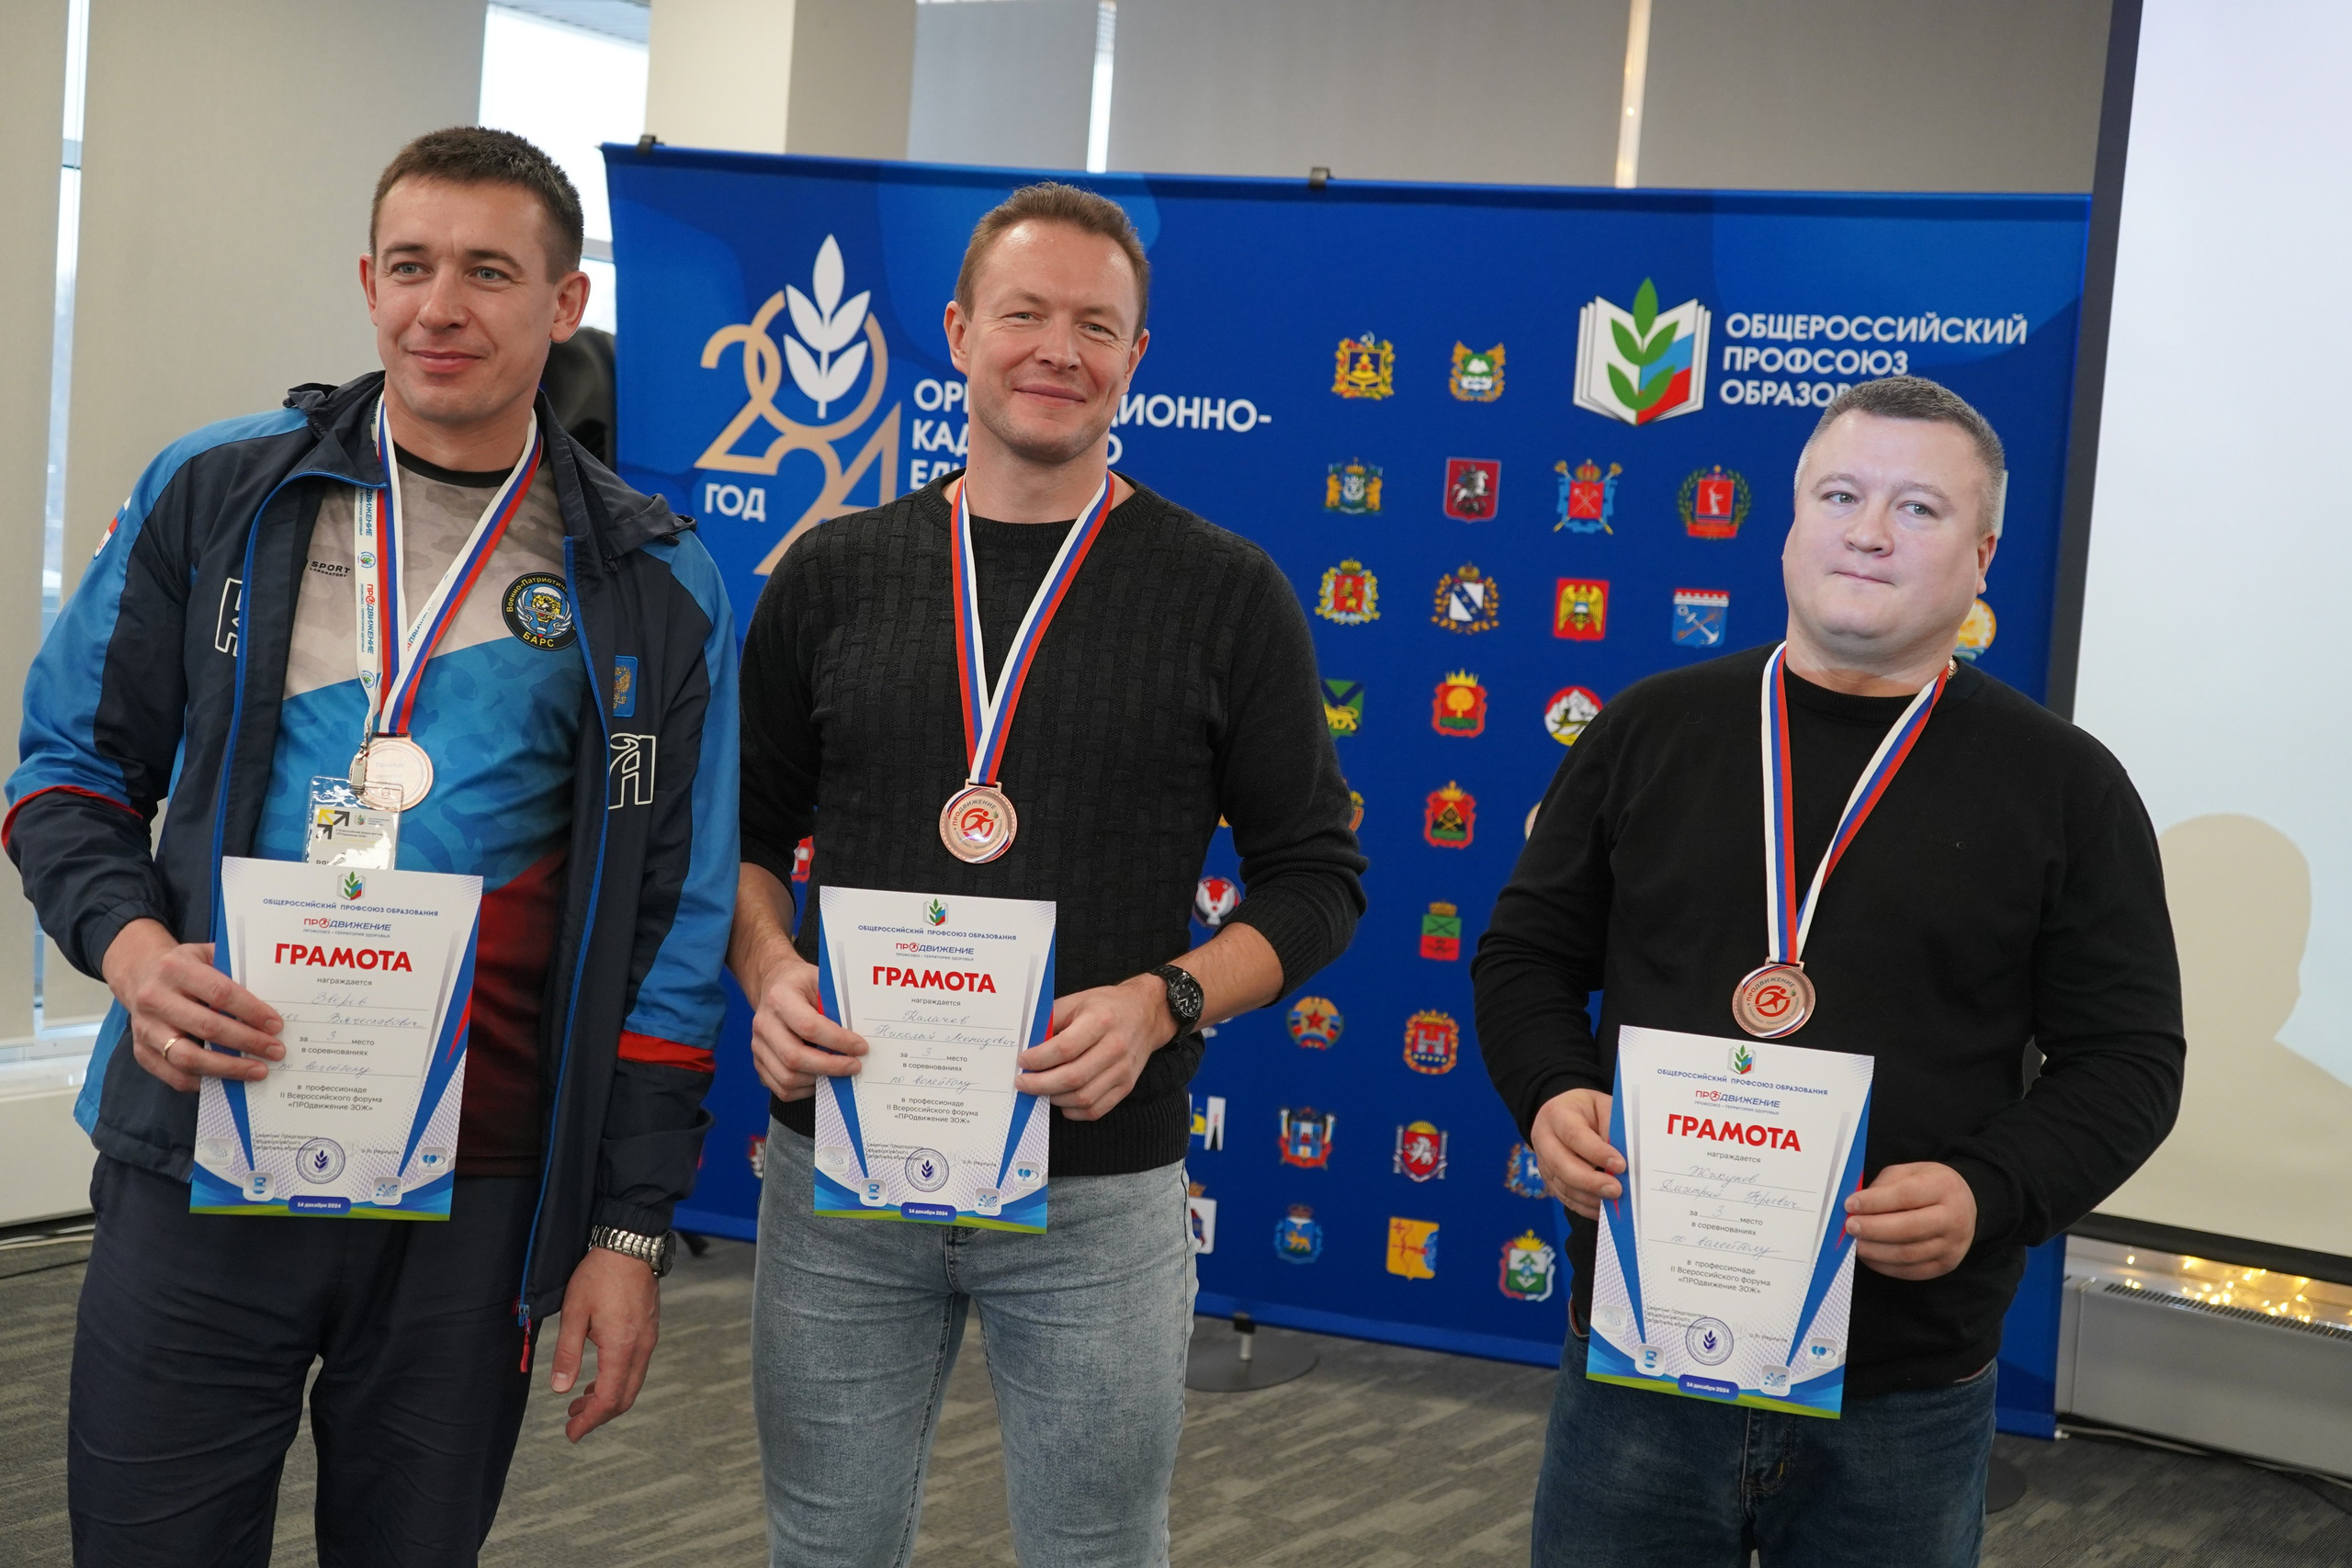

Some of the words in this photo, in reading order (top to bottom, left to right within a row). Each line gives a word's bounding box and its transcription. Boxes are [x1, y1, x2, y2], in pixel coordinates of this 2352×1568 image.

[1725, 312, 2028, 345] ОБЩЕРОССИЙСКИЙ
[1723, 346, 1908, 377] ПРОФСОЮЗ
[704, 483, 766, 523] ГОД
[309, 567, 347, 578] LABORATORY
[311, 560, 351, 573] SPORT
[523, 631, 555, 648] БАРС
[952, 798, 997, 827] ПРОДВИЖЕНИЕ
[263, 898, 337, 909] ОБЩЕРОССИЙСКИЙ
[340, 904, 384, 913] ПРОФСОЮЗ
[386, 908, 438, 917] ОБРАЗОВАНИЯ
[858, 924, 924, 935] ОБЩЕРОССИЙСКИЙ
[927, 930, 967, 938] ПРОФСОЮЗ
[968, 932, 1017, 941] ОБРАЗОВАНИЯ
[275, 942, 413, 973] ГРАМОТА
[317, 977, 372, 987] награждается
[873, 966, 997, 994] ГРАМОТА
[1747, 976, 1796, 1002] ПРОДВИЖЕНИЕ
[910, 998, 961, 1007] награждается
[308, 1047, 368, 1056] соревнованиях
[908, 1063, 963, 1072] соревнованиях
[1657, 1068, 1727, 1083] ОБЩЕРОССИЙСКИЙ
[1731, 1077, 1774, 1089] ПРОФСОЮЗ
[1775, 1084, 1828, 1096] ОБРАЗОВАНИЯ
[287, 1092, 351, 1102] Всероссийского
[352, 1096, 383, 1104] форума
[893, 1105, 950, 1115] Всероссийского
[951, 1109, 978, 1117] форума
[1667, 1113, 1802, 1152] ГРАМОТА
[1707, 1151, 1761, 1164] награждается
[1697, 1223, 1757, 1236] соревнованиях
[1739, 1217, 1763, 1226] место
[1677, 1267, 1739, 1282] Всероссийского
[1740, 1277, 1771, 1287] форума
